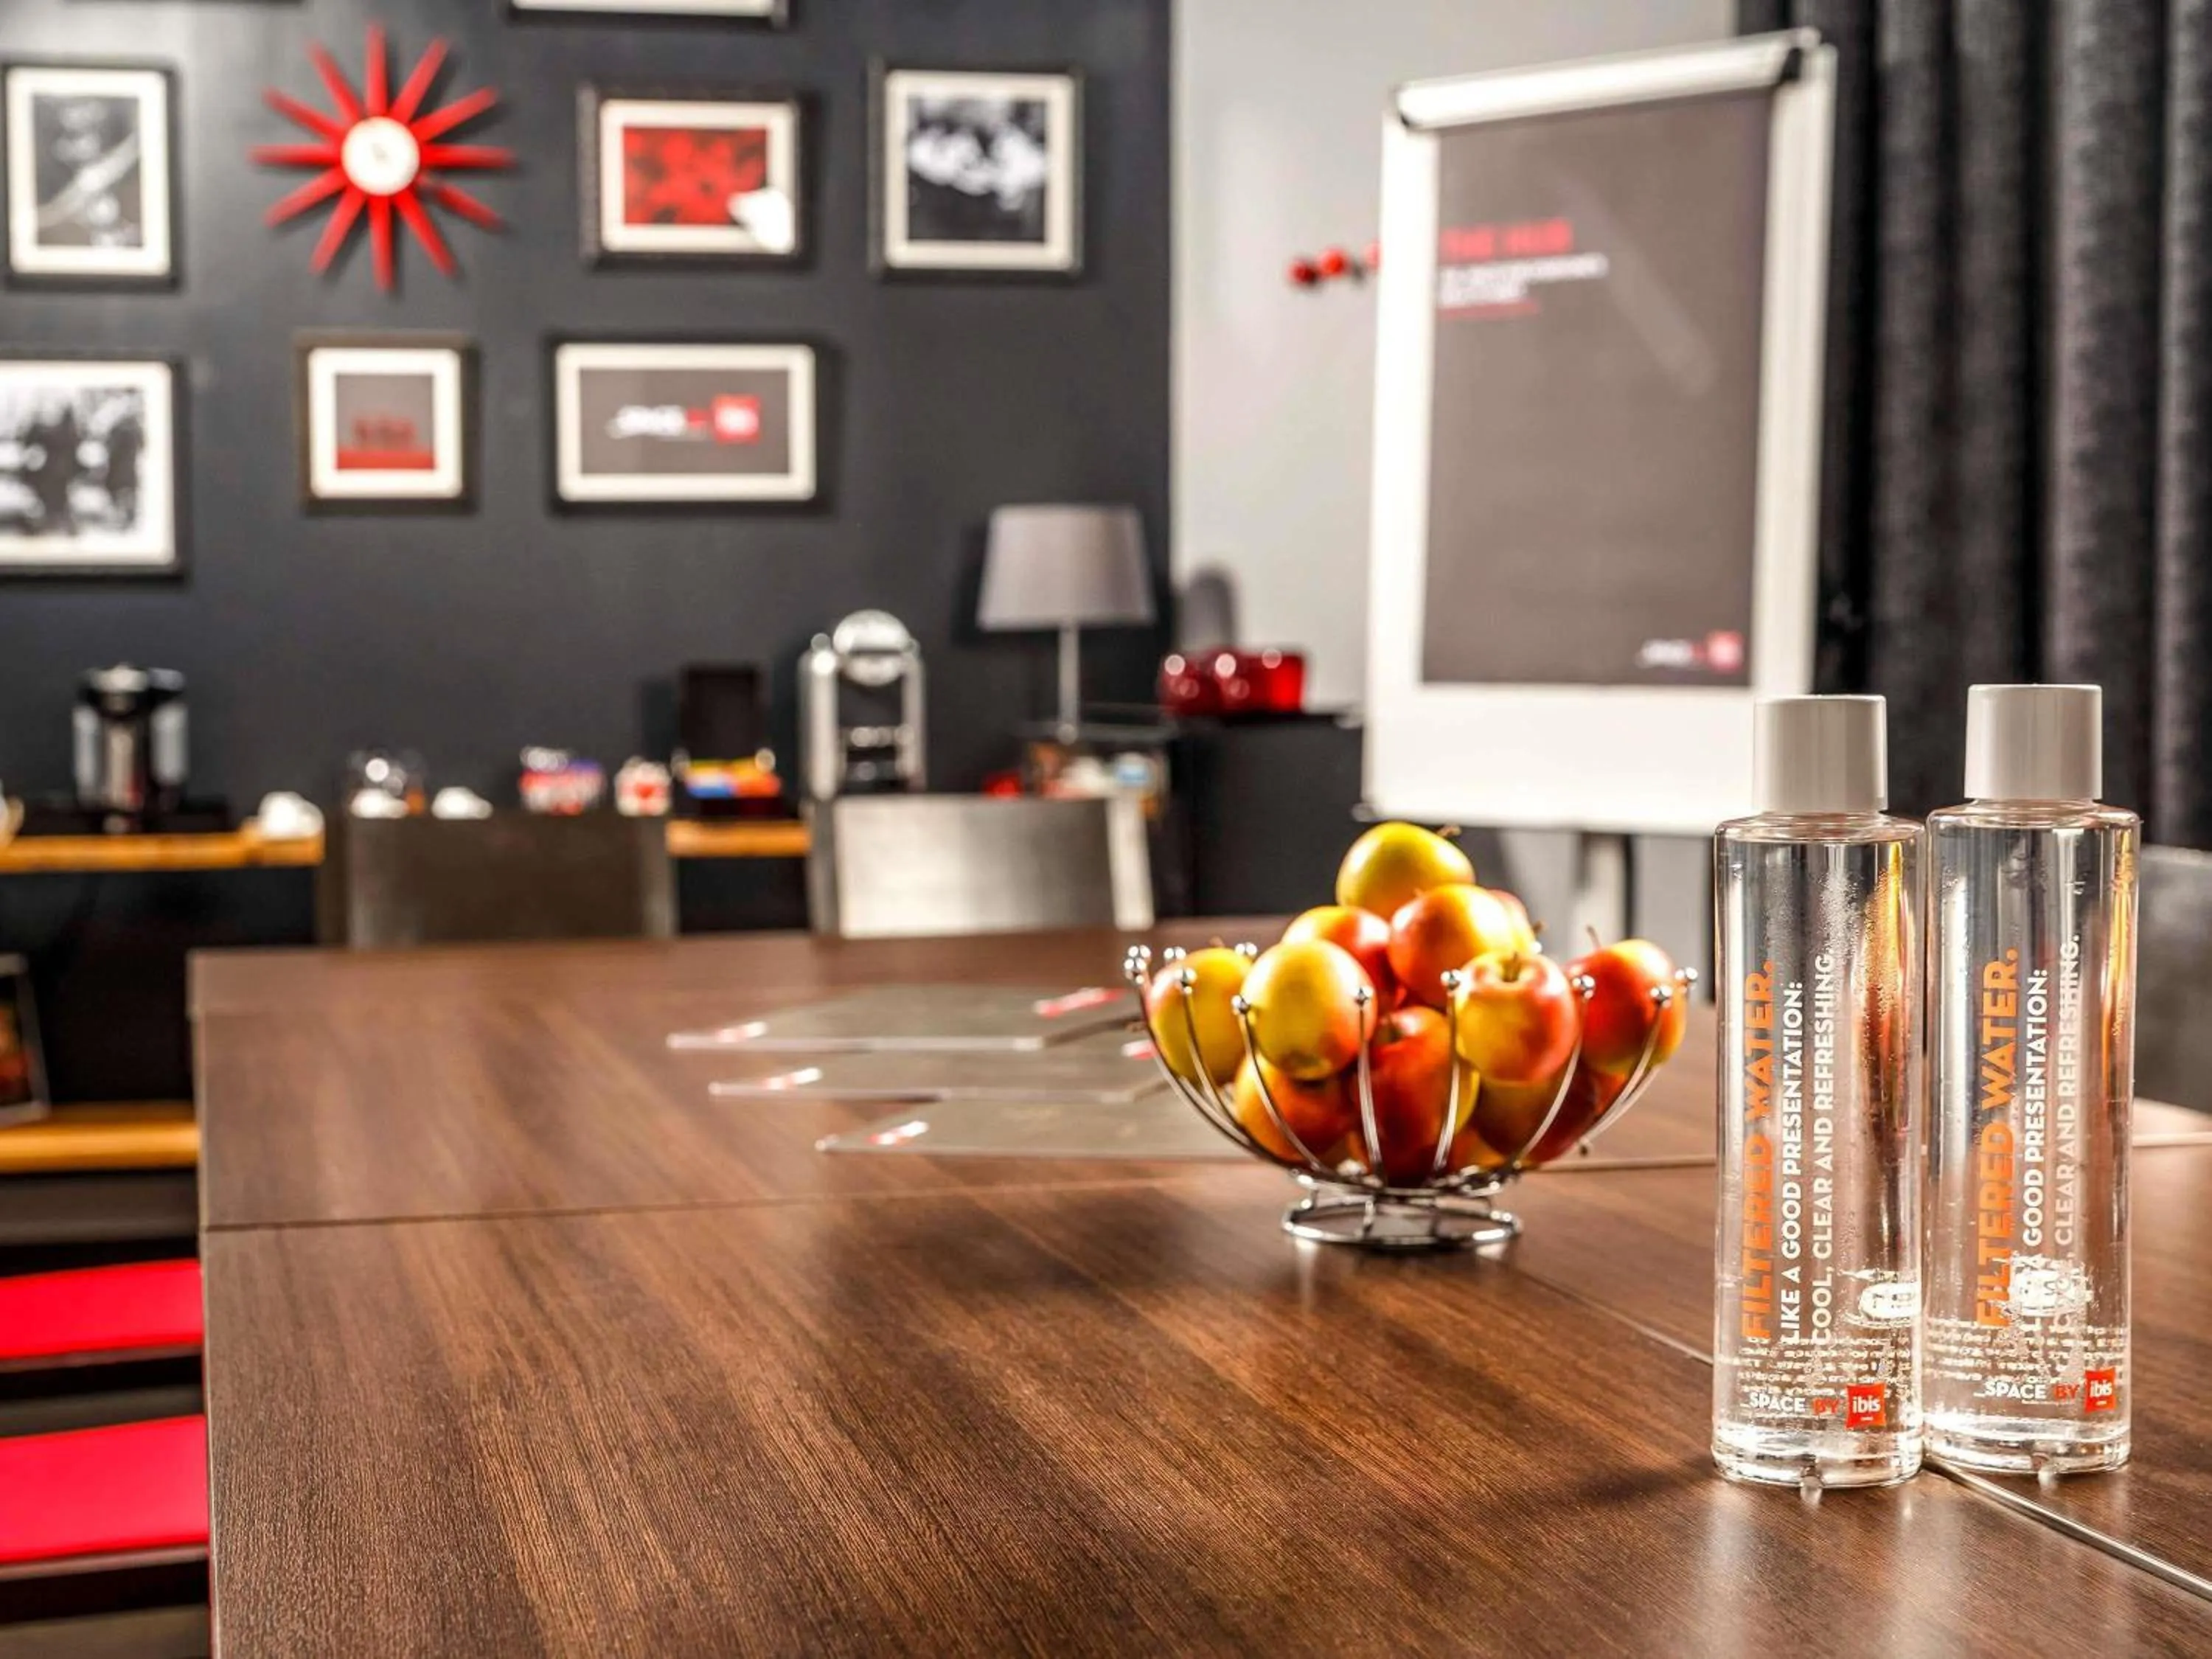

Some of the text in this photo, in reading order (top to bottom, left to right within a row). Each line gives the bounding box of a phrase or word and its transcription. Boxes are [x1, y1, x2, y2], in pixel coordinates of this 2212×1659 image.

[2057, 933, 2080, 1098] REFRESHING.
[2024, 969, 2048, 1163] PRESENTATION:
[1742, 960, 1775, 1338] FILTERED WATER.
[1781, 982, 1803, 1344] LIKE A GOOD PRESENTATION:
[1814, 1117, 1834, 1172] AND
[1976, 948, 2019, 1326] FILTERED WATER.
[2056, 1104, 2078, 1161] AND
[1812, 1179, 1834, 1259] CLEAR
[2023, 1169, 2043, 1247] GOOD
[2055, 1165, 2076, 1246] CLEAR
[1812, 1265, 1834, 1344] COOL,
[1812, 1398, 1840, 1416] BY
[1852, 1396, 1881, 1413] ibis
[2090, 1380, 2112, 1397] ibis
